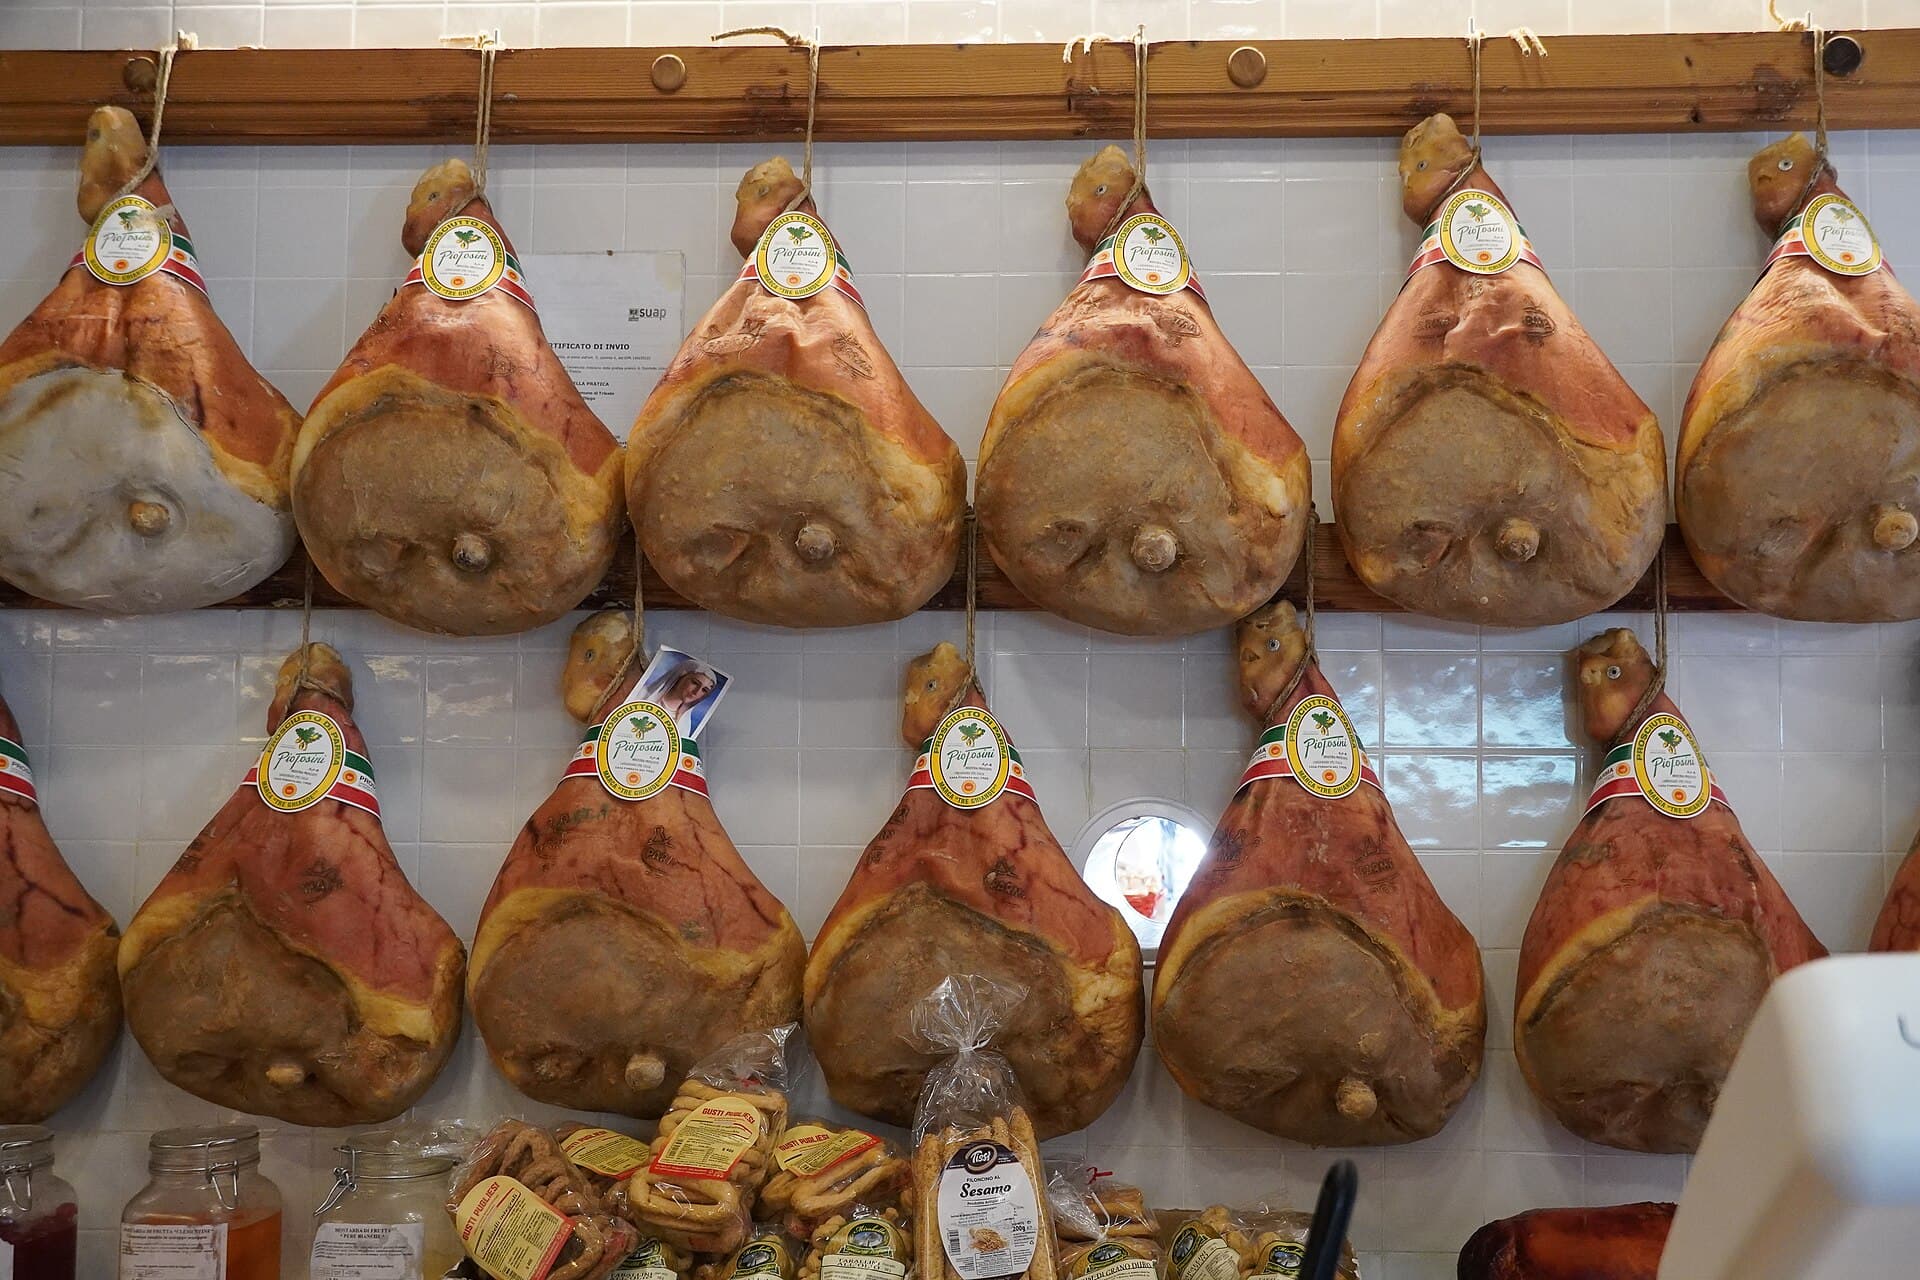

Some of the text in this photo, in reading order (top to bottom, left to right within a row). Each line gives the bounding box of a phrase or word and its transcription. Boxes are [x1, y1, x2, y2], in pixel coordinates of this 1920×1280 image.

[1443, 194, 1484, 232] PROSCIUTTO
[428, 220, 479, 254] PROSCIUTTO
[761, 216, 809, 251] PROSCIUTTO
[1117, 217, 1160, 249] PROSCIUTTO
[640, 308, 666, 320] suap
[601, 704, 654, 742] PROSCIUTTO
[665, 720, 678, 753] PARMA
[934, 711, 981, 754] PROSCIUTTO
[993, 726, 1007, 760] PARMA
[1288, 699, 1328, 742] PROSCIUTTO
[267, 715, 322, 753] PROSCIUTTO
[331, 731, 341, 766] PARMA
[1636, 717, 1674, 760] PROSCIUTTO
[702, 1108, 724, 1116] GUSTI
[799, 1134, 830, 1144] PUGLIESI
[960, 1183, 1011, 1198] Sesamo
[462, 1181, 500, 1241] GUSTI PUGLIESI
[1012, 1225, 1025, 1233] 200g
[1106, 1263, 1131, 1277] GRANO
